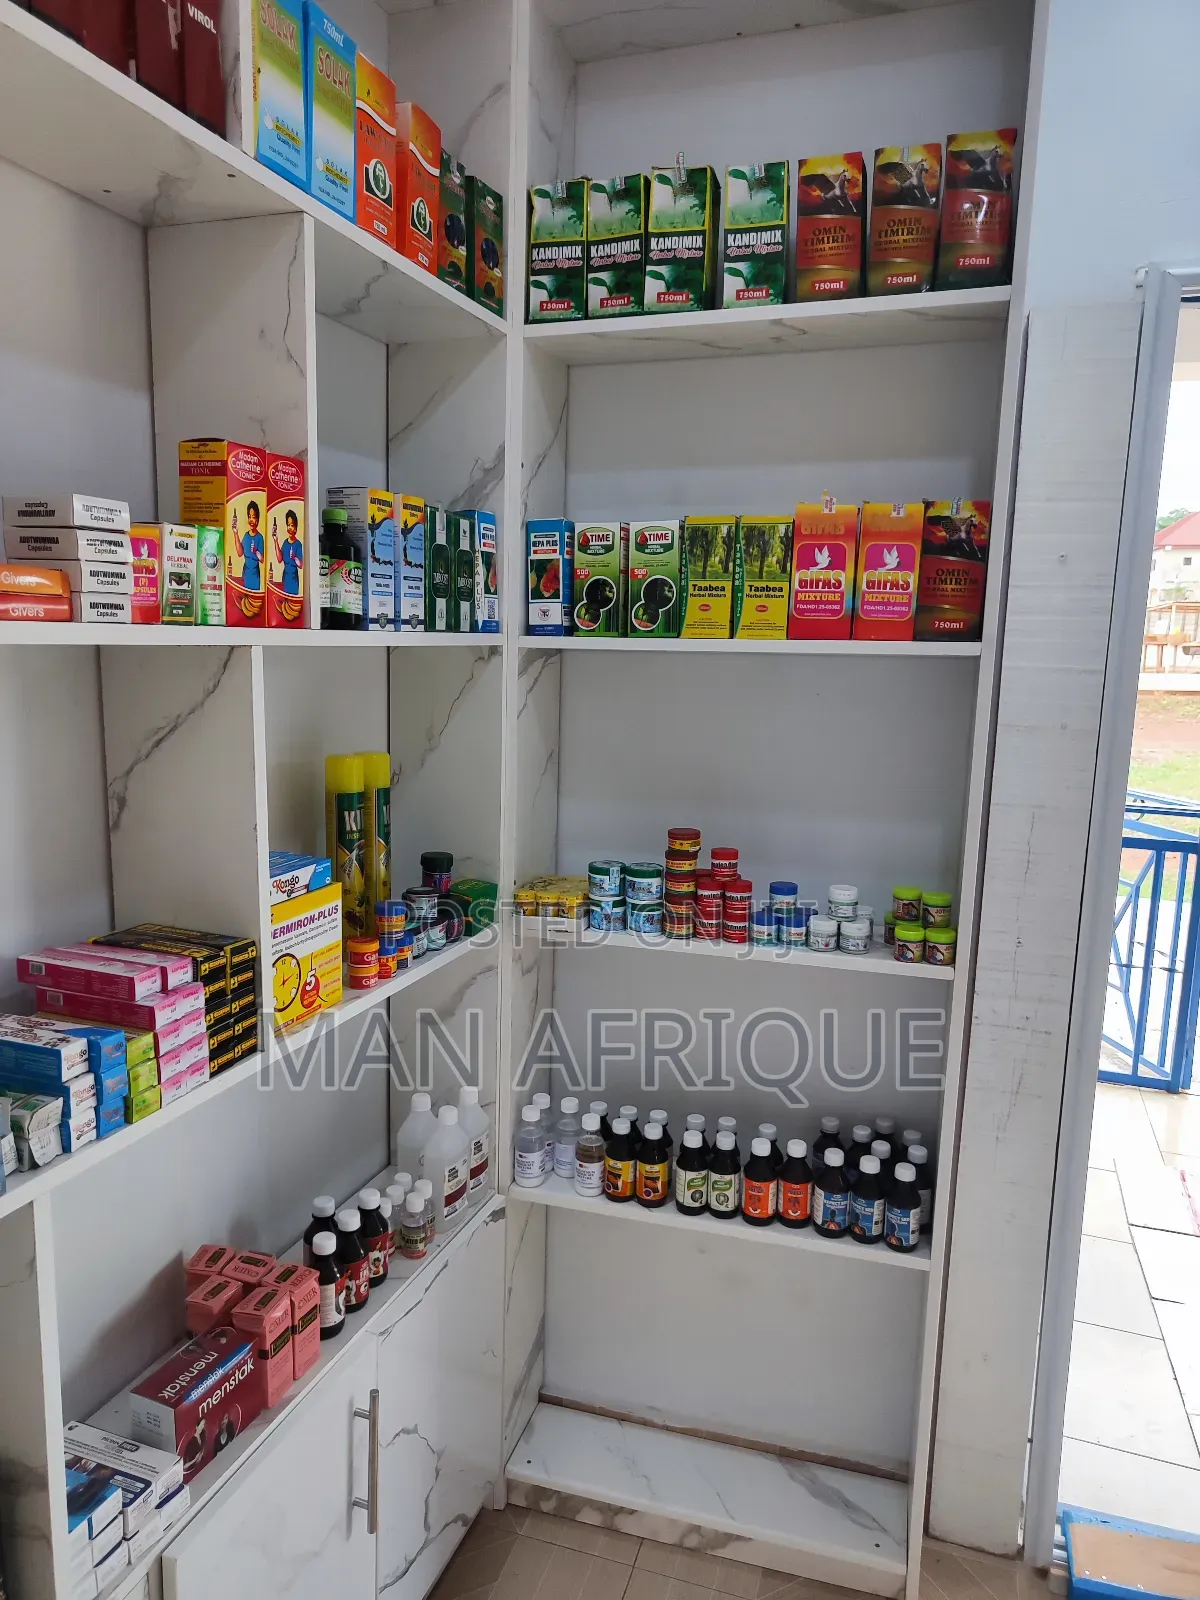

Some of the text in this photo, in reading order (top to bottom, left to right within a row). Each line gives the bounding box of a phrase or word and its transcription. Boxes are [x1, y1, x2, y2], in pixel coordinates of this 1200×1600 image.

[187, 3, 217, 34] VIROL
[260, 0, 299, 54] SOLAK
[323, 18, 344, 47] 750mL
[317, 45, 352, 99] SOLAK
[887, 216, 922, 228] OMIN
[812, 225, 846, 236] OMIN
[651, 235, 703, 250] KANDIMIX
[727, 230, 782, 246] KANDIMIX
[532, 246, 582, 260] KANDIMIX
[590, 239, 641, 257] KANDIMIX
[958, 257, 990, 266] 750ml
[887, 274, 917, 284] 750ml
[814, 281, 844, 290] 750ml
[660, 292, 686, 302] 750ml
[738, 289, 766, 299] 750ml
[543, 302, 568, 310] 750ml
[603, 297, 628, 307] 750ml
[238, 451, 259, 463] Madam
[190, 467, 212, 475] TONIC
[230, 458, 261, 474] Catherine
[239, 470, 256, 480] TONIC
[270, 469, 299, 484] Catherine
[90, 514, 115, 523] Capsules
[590, 533, 611, 543] TIME
[648, 532, 670, 542] TIME
[27, 544, 52, 552] Capsules
[94, 547, 118, 555] Capsules
[935, 568, 970, 577] OMIN
[1, 571, 37, 587] Givers
[96, 579, 120, 587] Capsules
[797, 570, 843, 590] GIFAS
[865, 570, 911, 592] GIFAS
[691, 584, 726, 592] Taabea
[748, 584, 784, 593] Taabea
[797, 592, 841, 601] MIXTURE
[864, 594, 909, 603] MIXTURE
[9, 607, 45, 617] Givers
[96, 610, 119, 618] Capsules
[934, 621, 964, 629] 750ml
[272, 875, 300, 894] Kongo
[271, 904, 339, 939] ERMIRON-PLUS
[305, 968, 317, 991] 5
[158, 1351, 219, 1400] menstak
[198, 1356, 255, 1418] menstak
